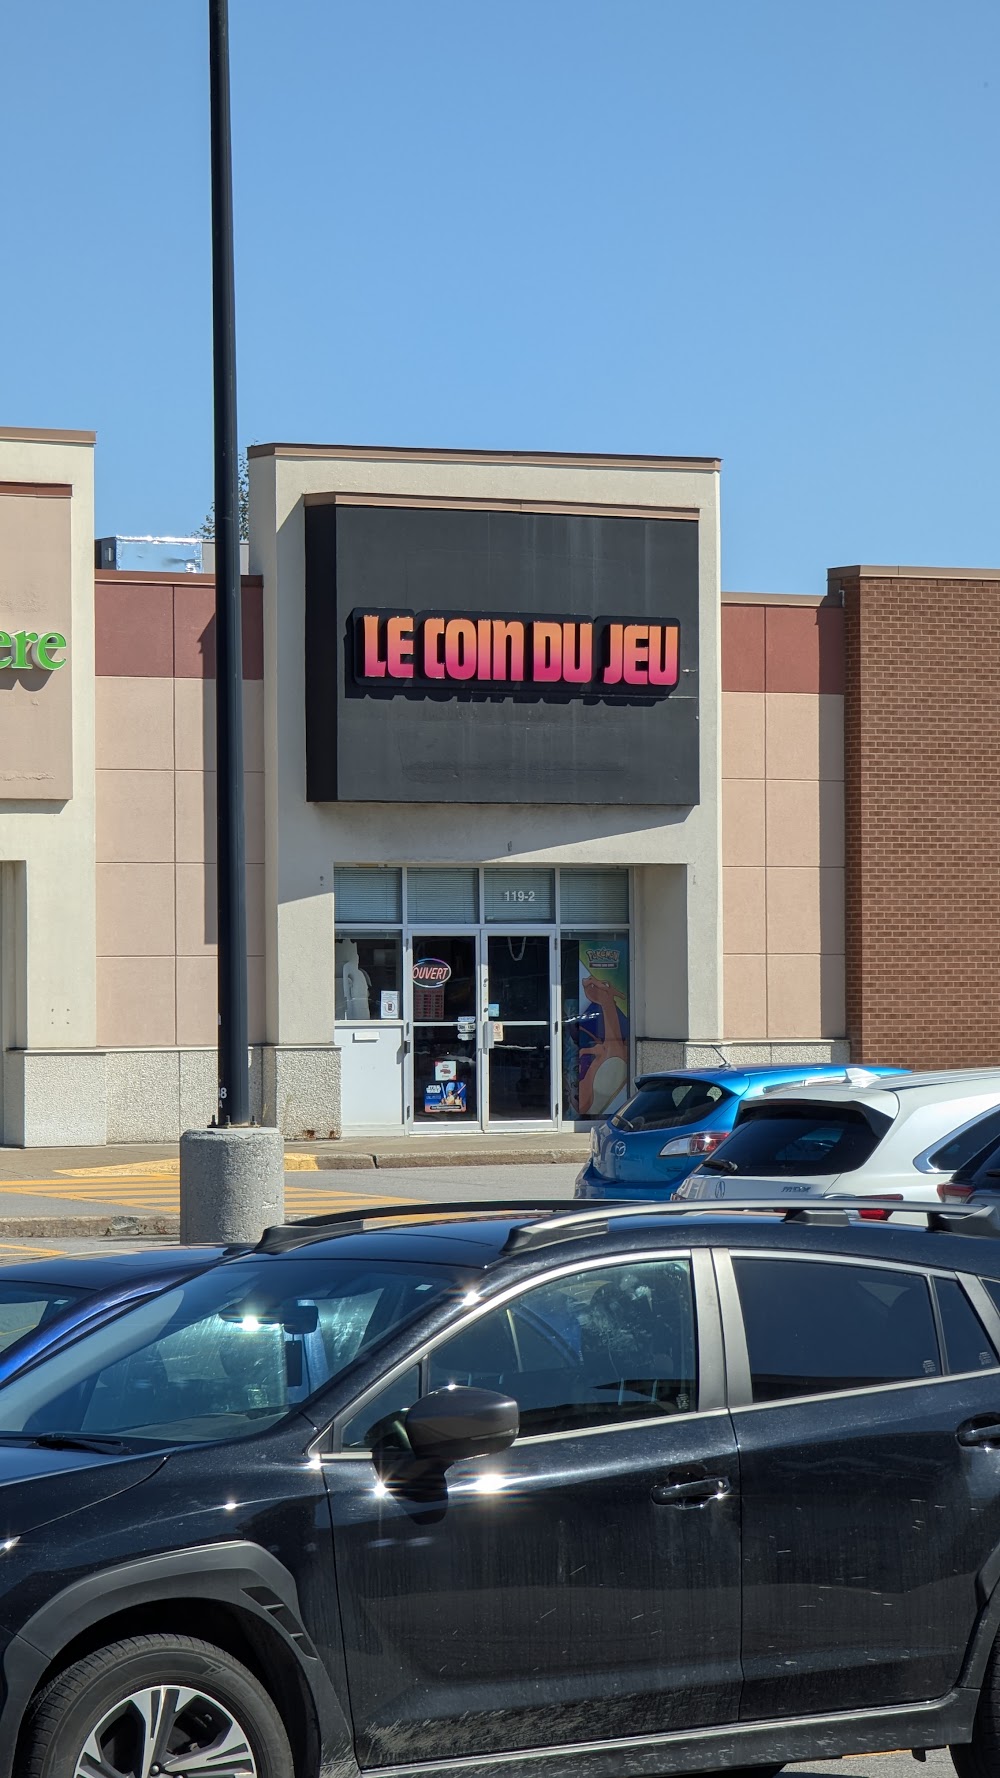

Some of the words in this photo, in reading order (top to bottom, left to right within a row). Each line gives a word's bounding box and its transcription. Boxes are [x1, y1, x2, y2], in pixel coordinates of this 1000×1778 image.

[363, 615, 414, 679] LE
[533, 620, 593, 683] DU
[603, 623, 679, 686] JEU
[504, 890, 536, 901] 119-2
[413, 966, 449, 980] OUVERT
